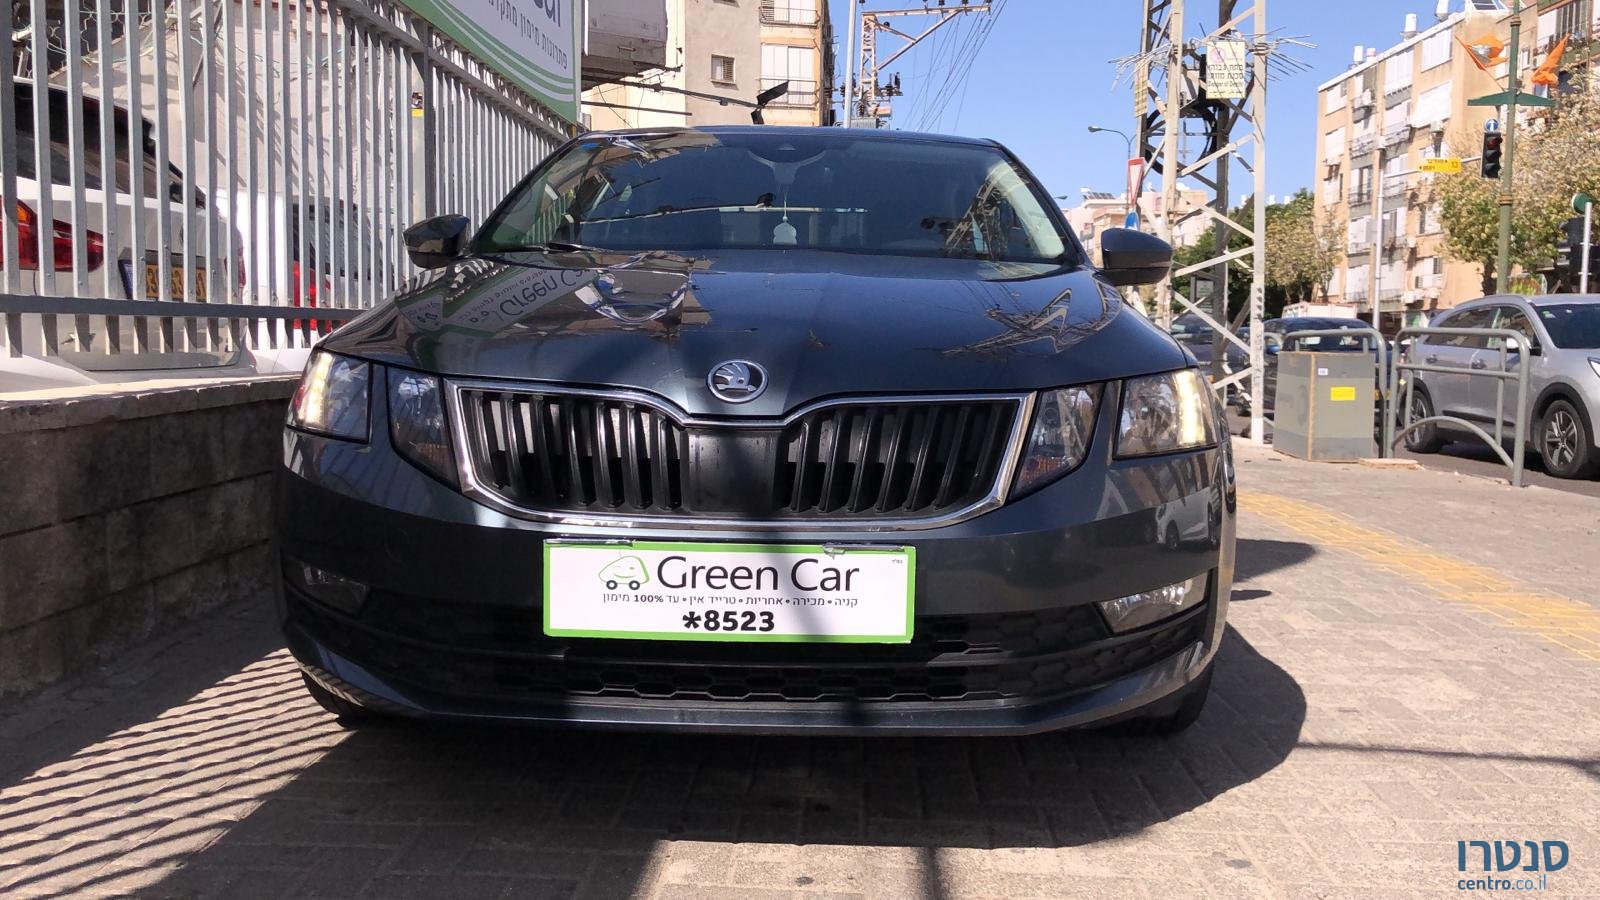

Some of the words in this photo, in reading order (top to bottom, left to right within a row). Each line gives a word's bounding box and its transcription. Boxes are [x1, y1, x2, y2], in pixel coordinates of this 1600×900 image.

[520, 13, 540, 47] מימון
[542, 33, 568, 70] פתרונות
[657, 555, 779, 590] Green
[790, 558, 860, 592] Car
[603, 593, 630, 603] מימון
[634, 594, 664, 603] 100%
[666, 595, 680, 603] עד
[689, 596, 705, 605] אין
[708, 596, 736, 605] טרייד
[745, 597, 783, 605] אחריות
[793, 597, 825, 606] מכירה
[834, 598, 858, 607] קניה
